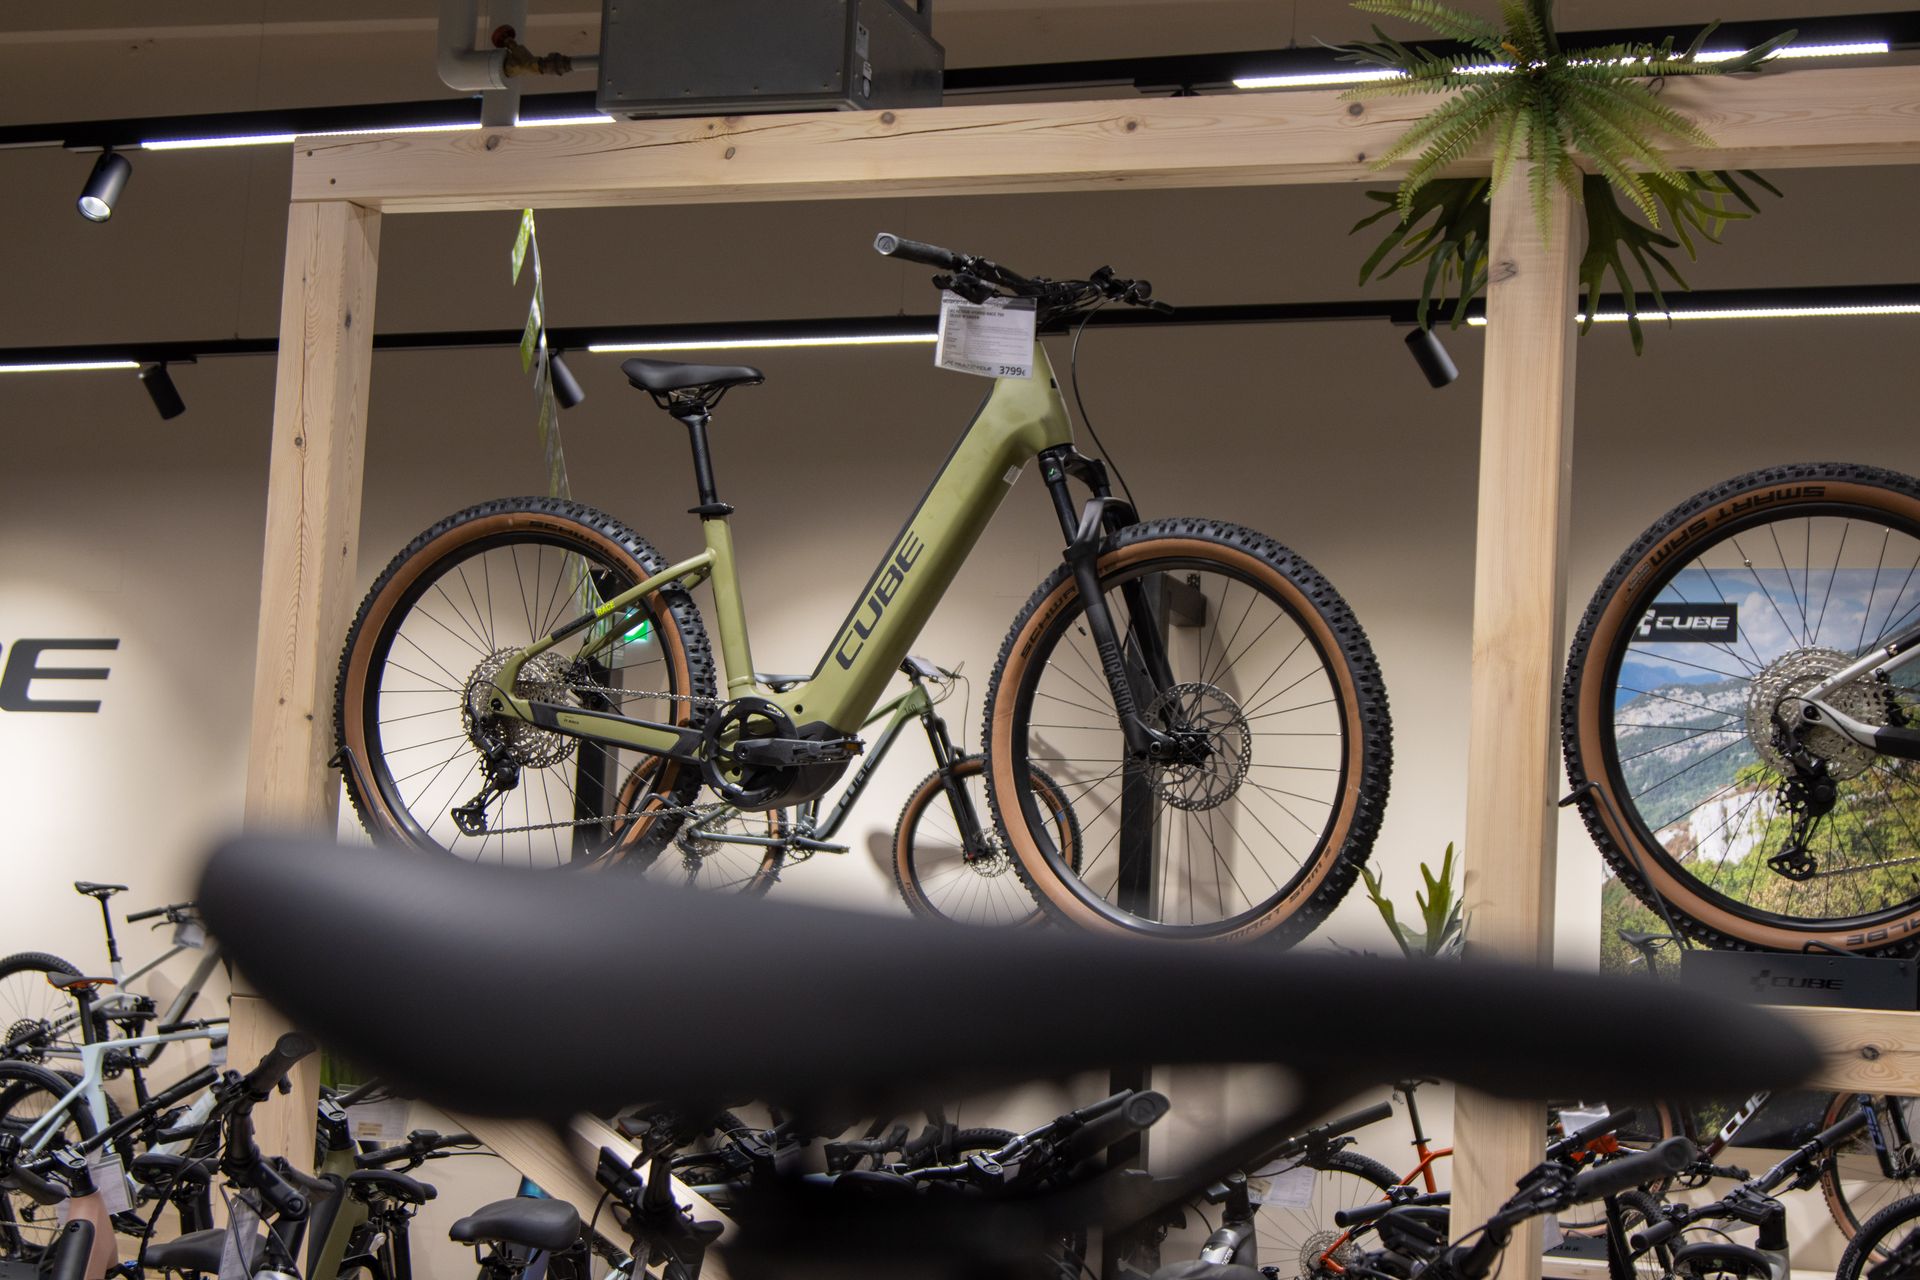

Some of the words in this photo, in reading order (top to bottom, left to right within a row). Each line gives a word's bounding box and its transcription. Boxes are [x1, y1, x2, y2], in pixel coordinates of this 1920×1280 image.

[999, 366, 1026, 377] 3799€
[1715, 486, 1826, 522] SMART
[1650, 517, 1709, 567] SAM
[596, 600, 615, 616] RACE
[836, 531, 925, 671] CUBE
[1655, 616, 1731, 631] CUBE
[1770, 976, 1844, 990] CUBE
[1719, 1089, 1772, 1143] CUB
